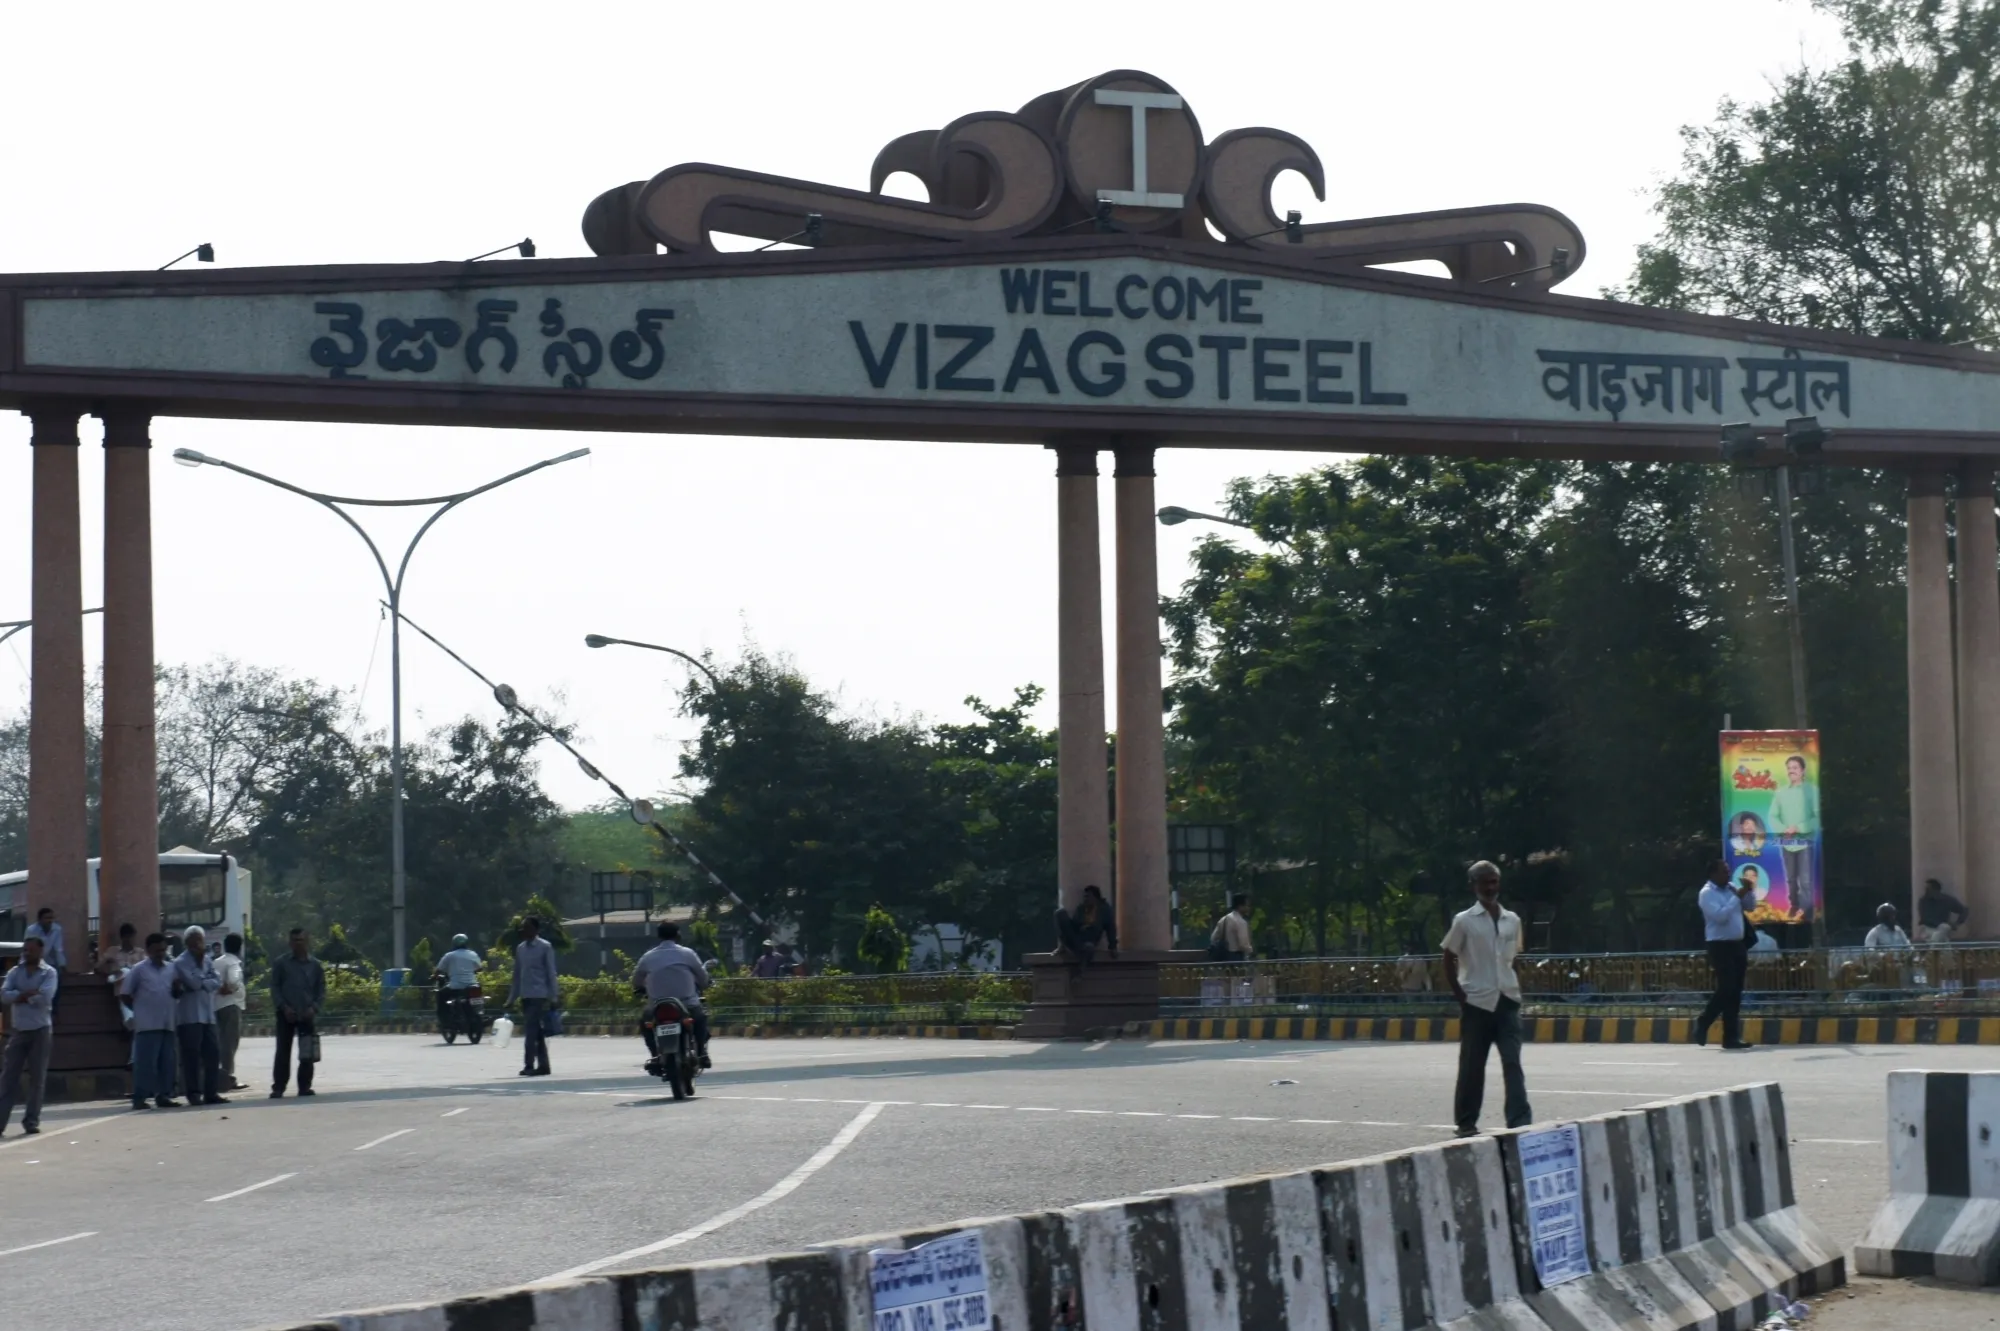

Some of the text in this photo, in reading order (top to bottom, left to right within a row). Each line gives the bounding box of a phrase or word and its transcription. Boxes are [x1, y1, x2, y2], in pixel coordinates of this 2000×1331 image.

[1001, 268, 1264, 324] WELCOME
[310, 299, 518, 380] వైజాగ్
[848, 320, 1408, 406] VIZAG STEEL
[1737, 347, 1850, 418] स्टील
